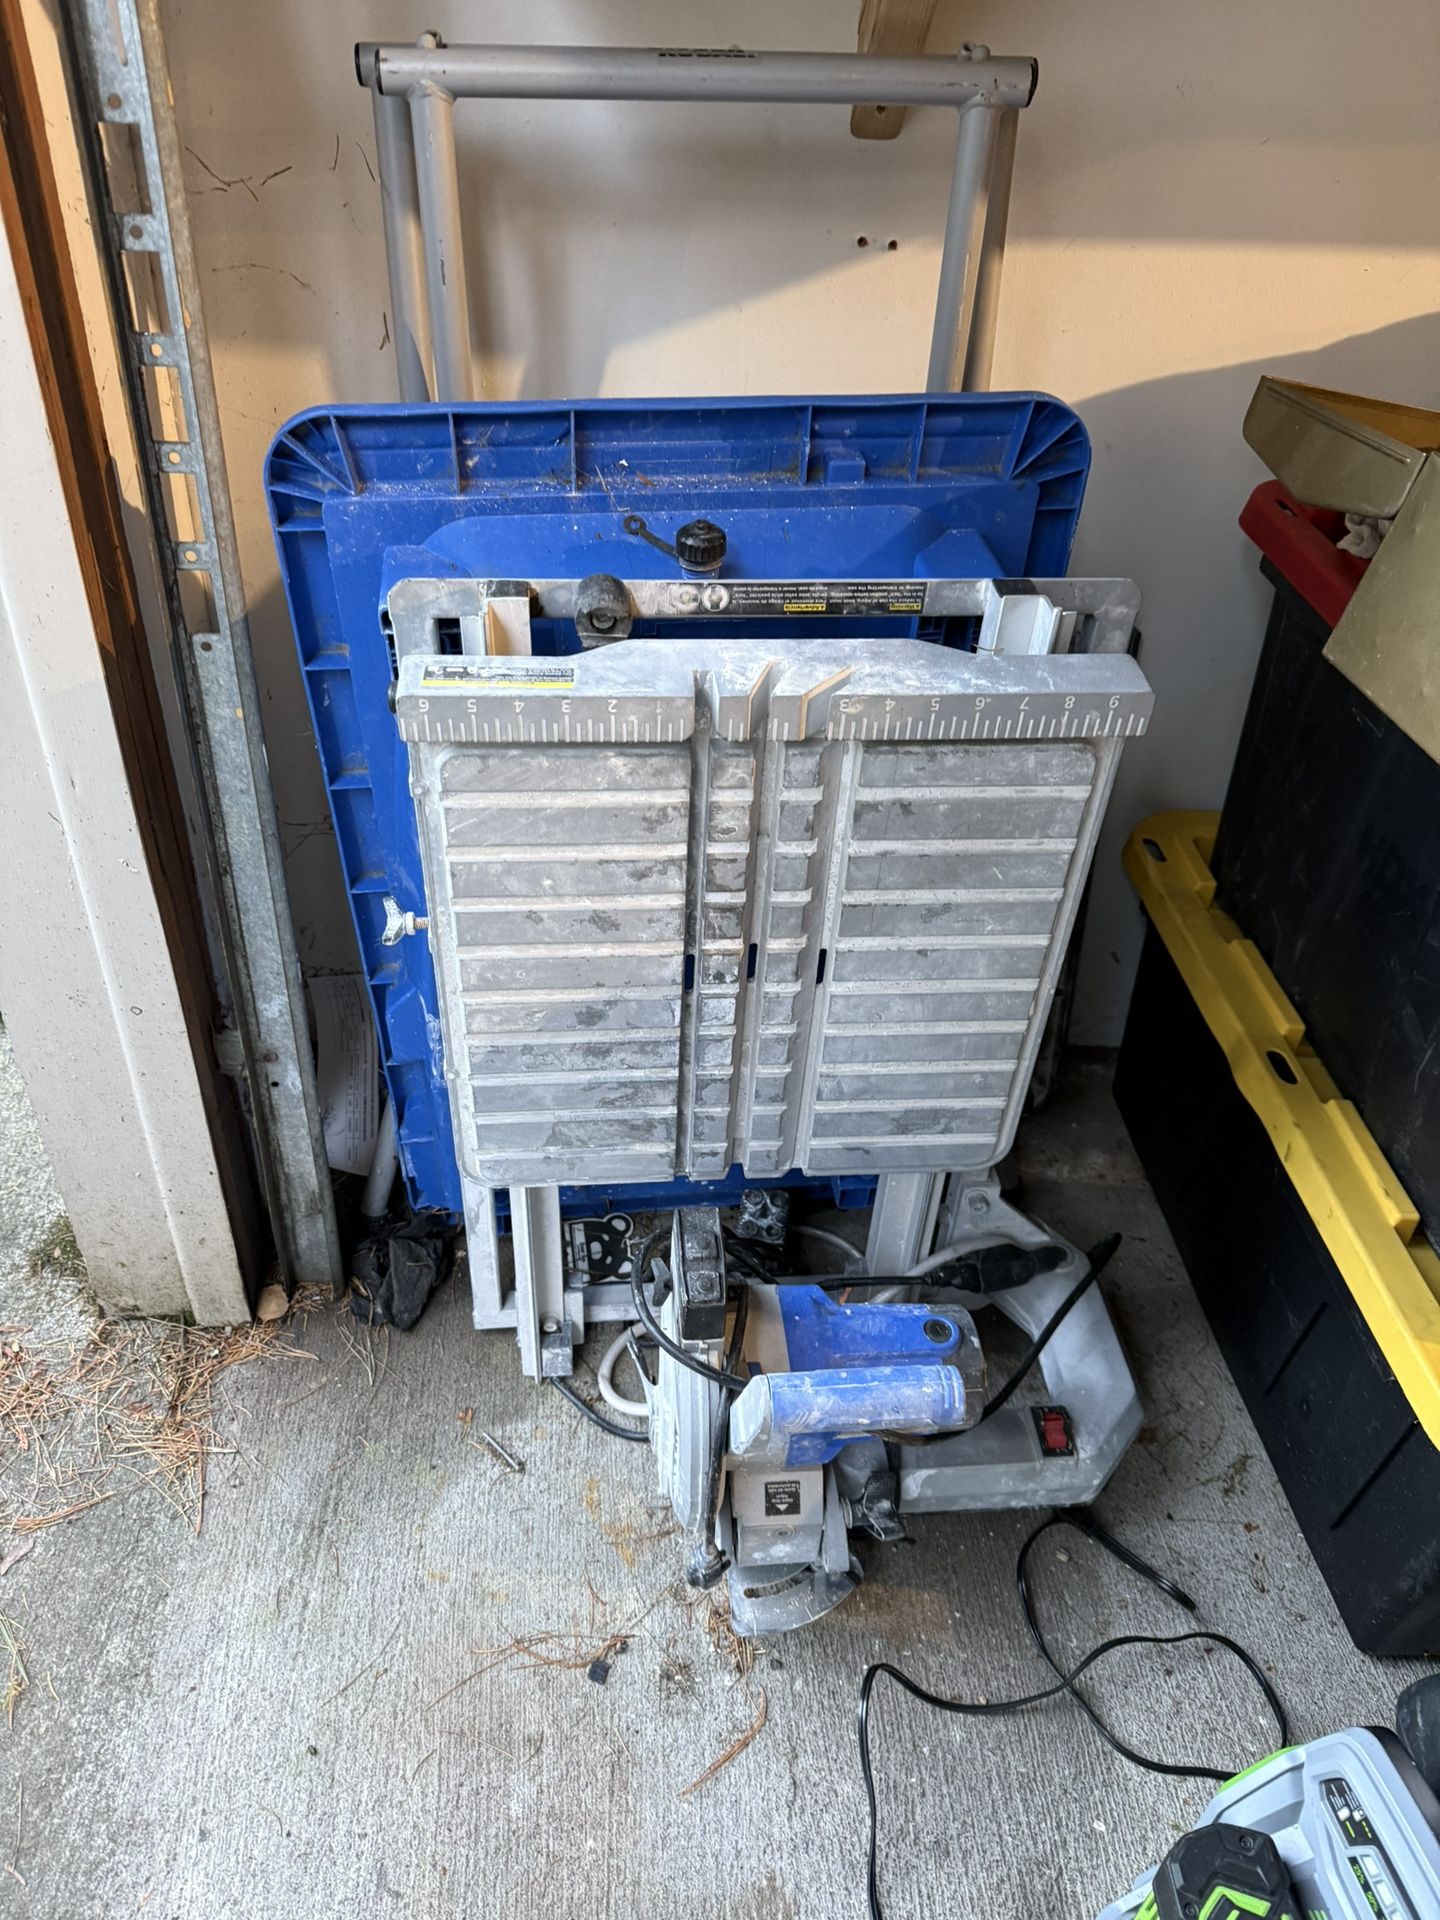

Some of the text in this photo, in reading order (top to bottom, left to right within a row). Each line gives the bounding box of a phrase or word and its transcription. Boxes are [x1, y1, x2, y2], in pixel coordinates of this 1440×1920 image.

[419, 699, 429, 711] 6
[467, 699, 477, 711] 5
[513, 700, 524, 711] 4
[561, 700, 571, 712] 3
[607, 700, 618, 712] 2
[840, 695, 1120, 710] 9 8 7 6 5 4 3
